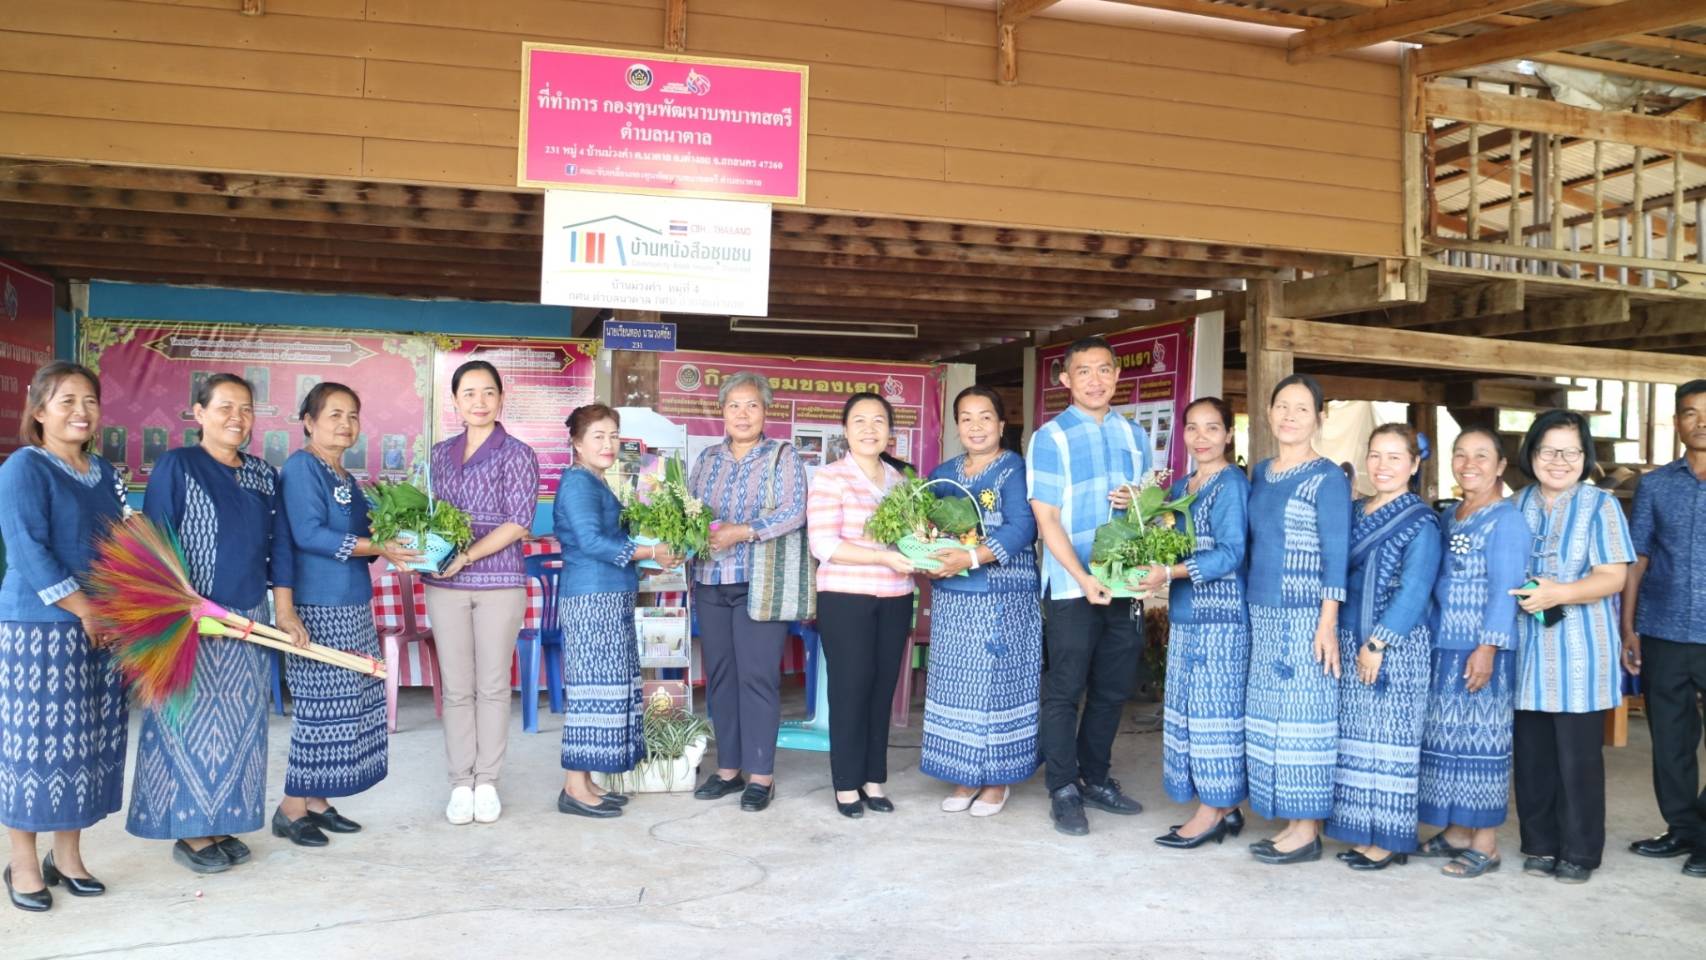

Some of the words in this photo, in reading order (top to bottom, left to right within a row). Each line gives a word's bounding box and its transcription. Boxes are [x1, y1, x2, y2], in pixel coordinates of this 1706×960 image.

[537, 82, 598, 112] ที่ทำการ
[603, 98, 793, 128] กองทุนพัฒนาบทบาทสตรี
[620, 122, 712, 146] ตำบลนาตาล
[630, 237, 751, 265] บ้านหนังสือชุมชน
